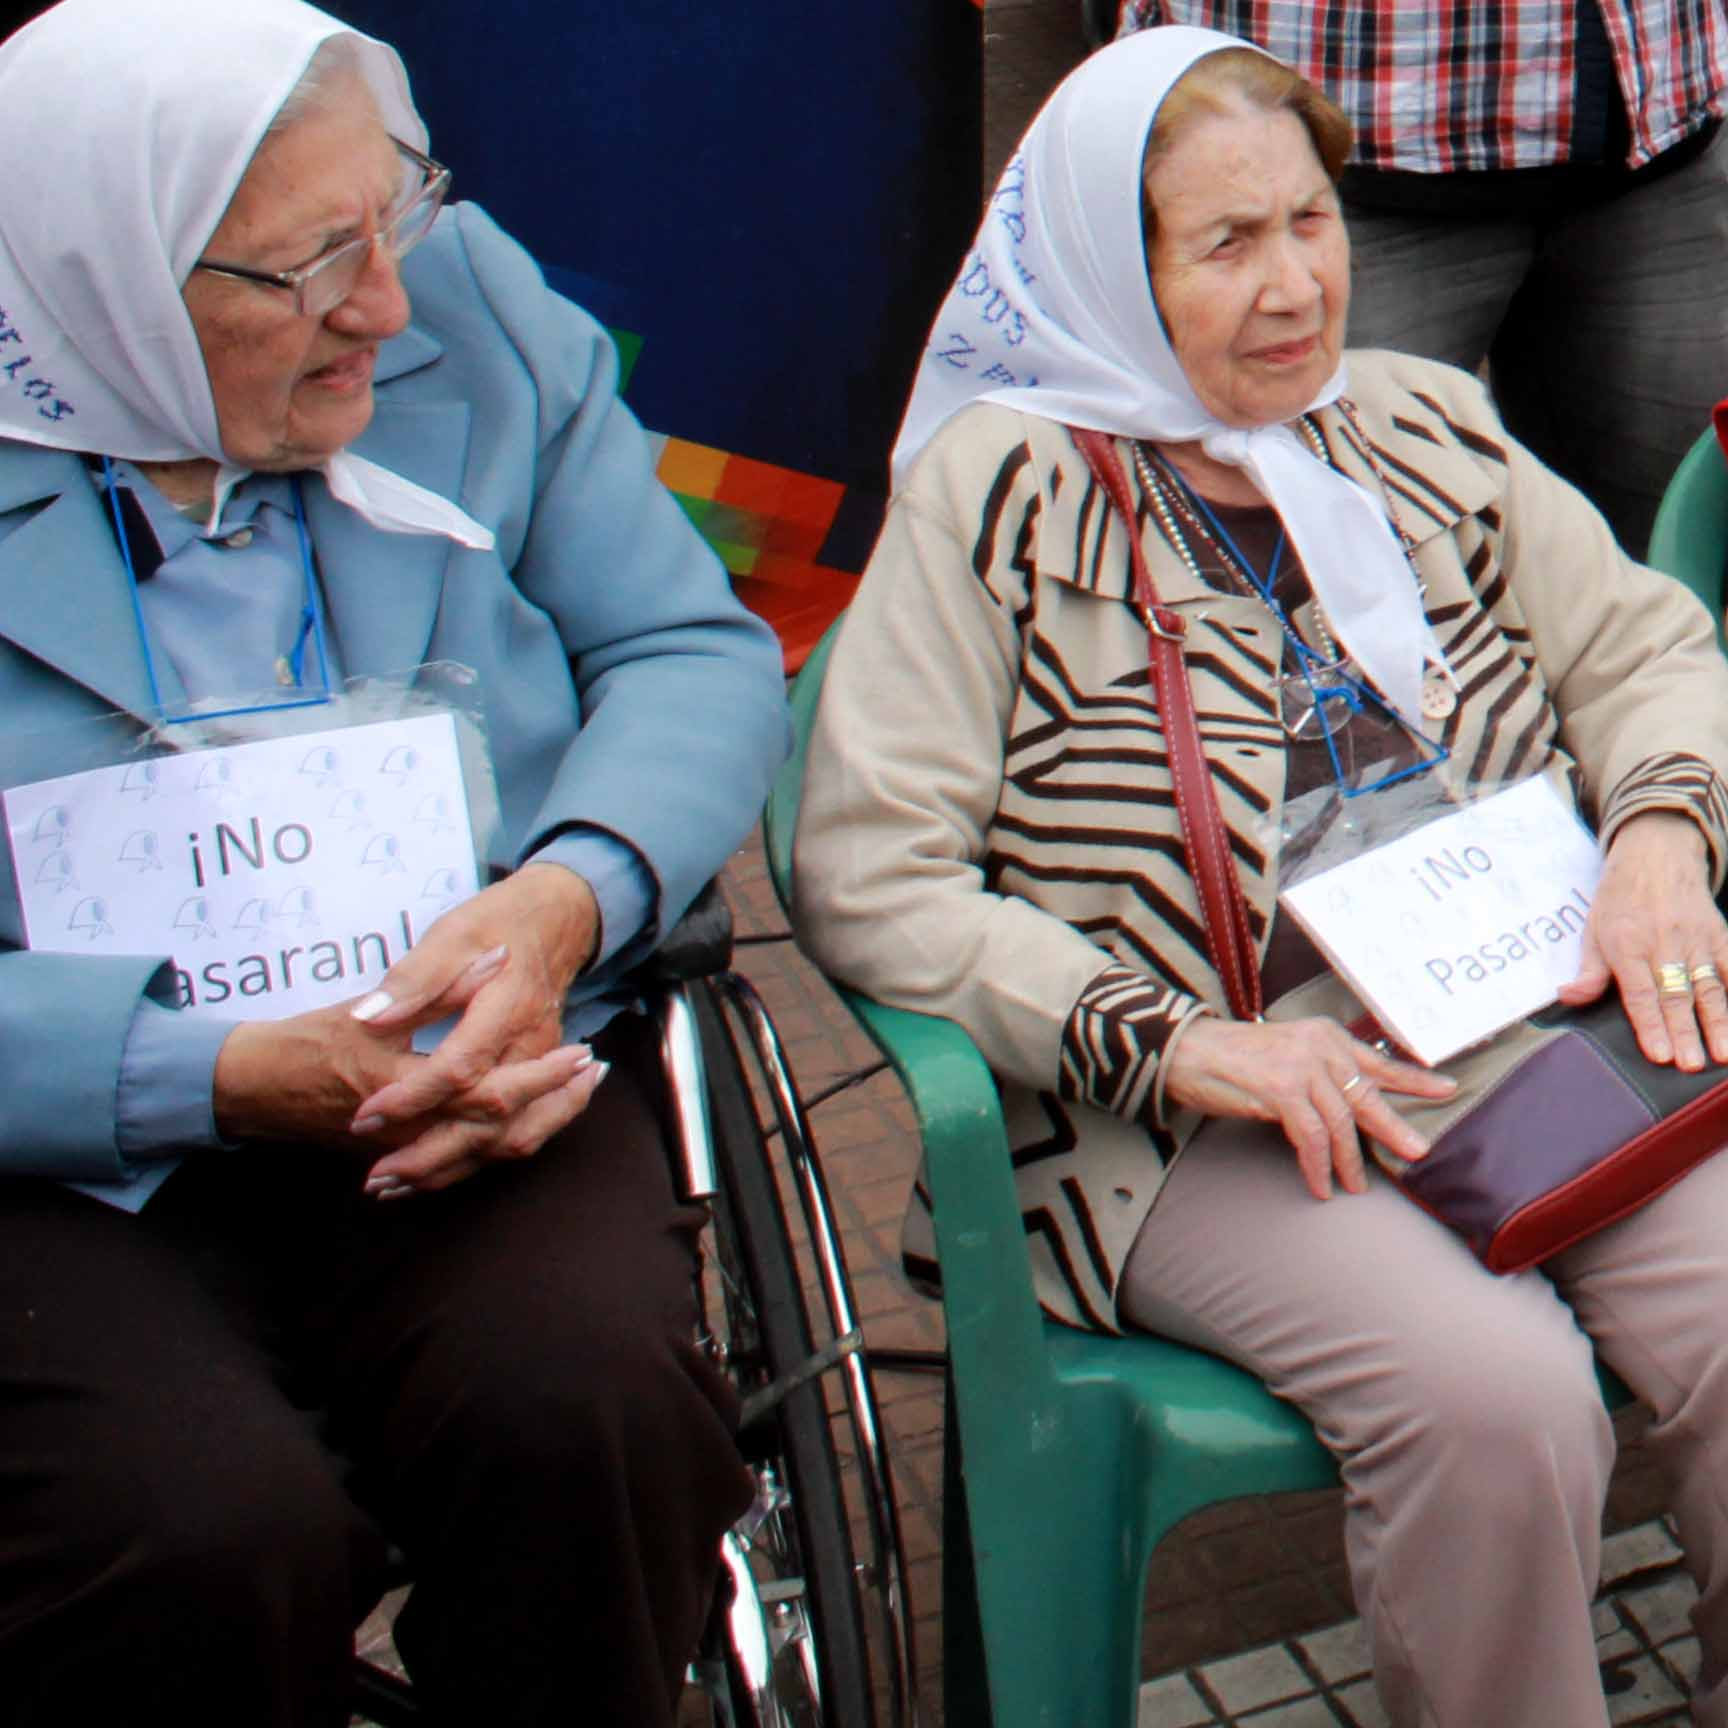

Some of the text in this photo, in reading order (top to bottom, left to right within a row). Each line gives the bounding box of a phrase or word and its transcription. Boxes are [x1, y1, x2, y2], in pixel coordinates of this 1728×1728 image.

[189, 816, 313, 888] ¡No
[1410, 843, 1493, 902] ¡No
[173, 910, 415, 1010] asaran!
